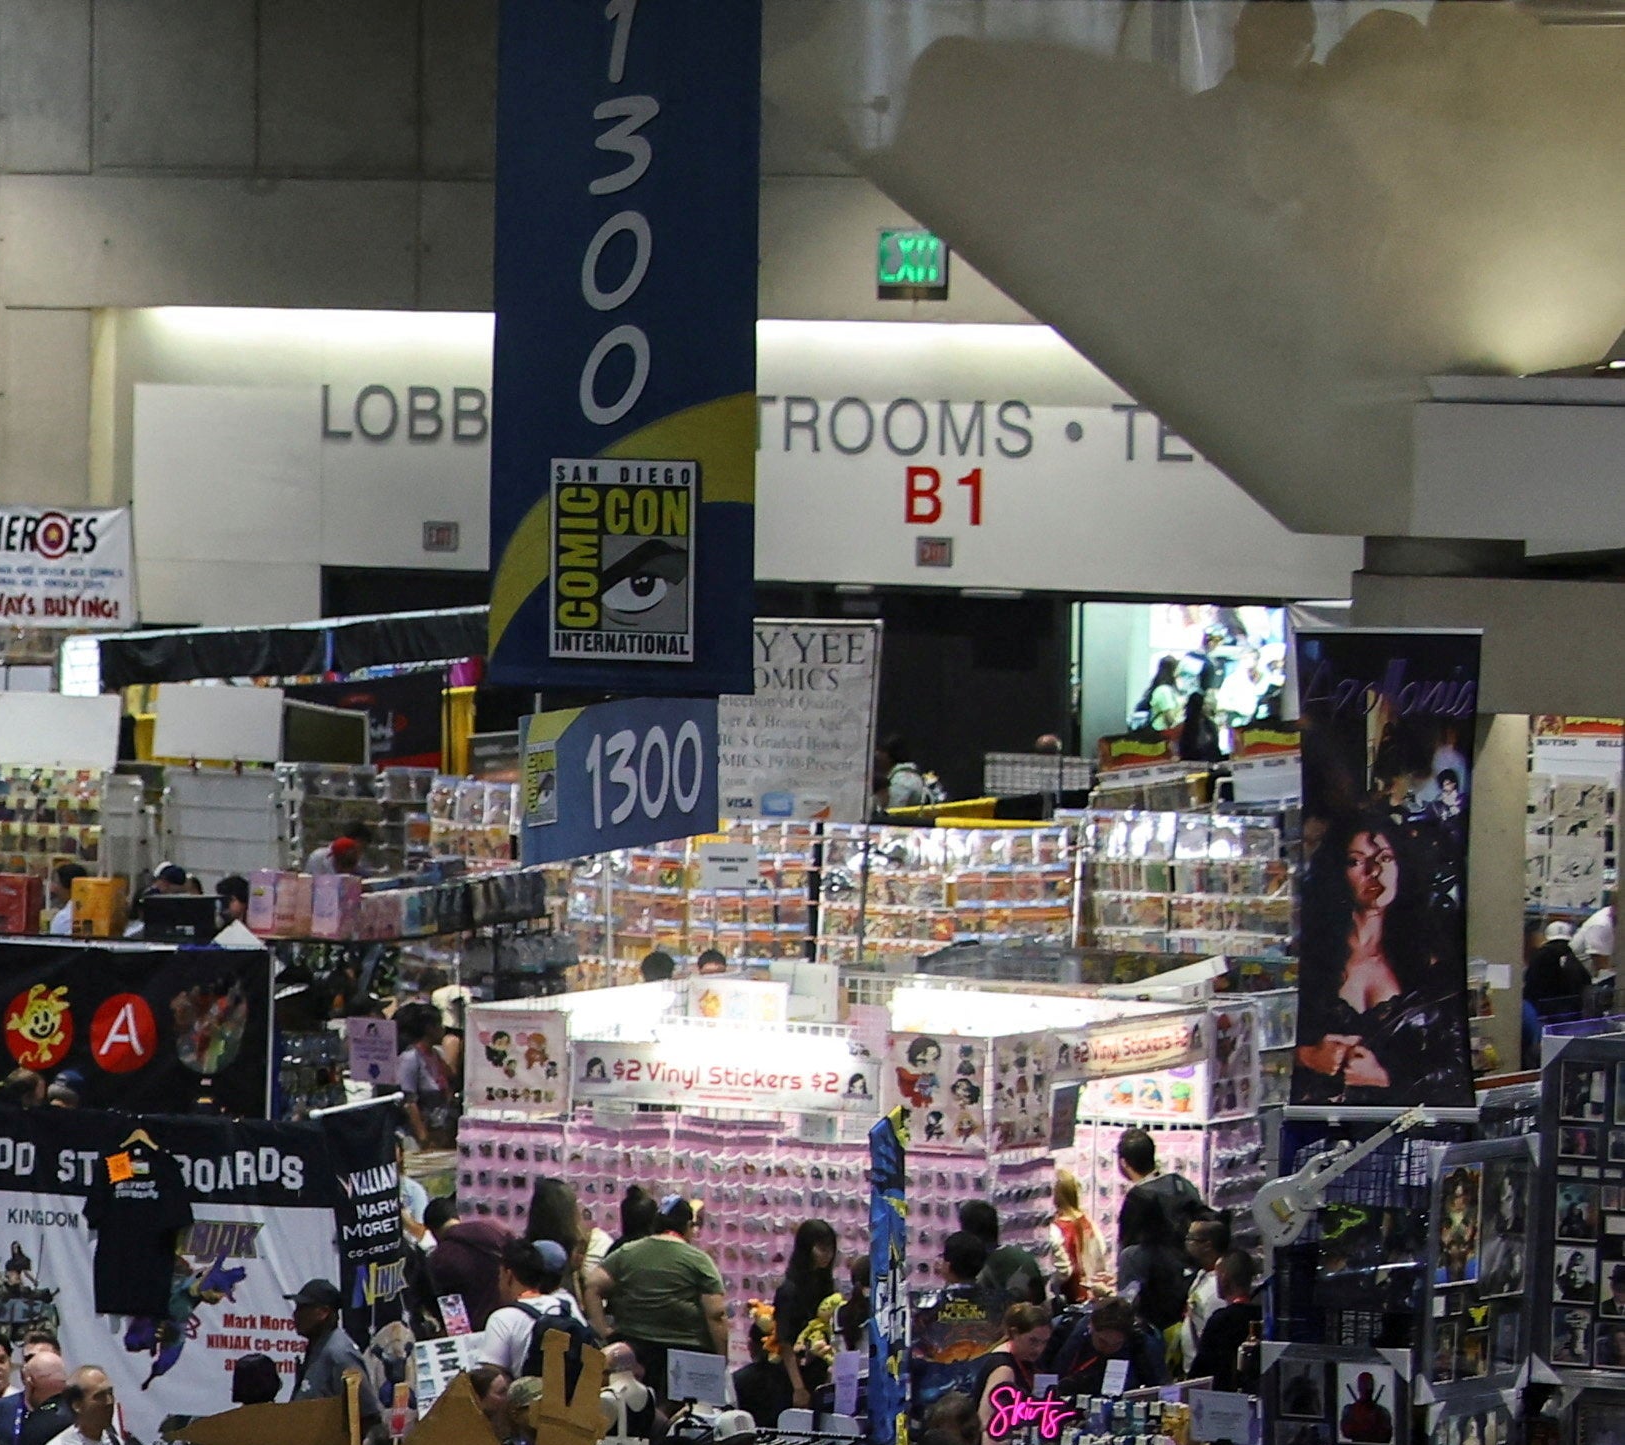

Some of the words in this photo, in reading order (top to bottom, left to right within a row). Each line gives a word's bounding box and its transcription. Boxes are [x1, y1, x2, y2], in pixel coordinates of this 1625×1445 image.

[555, 465, 596, 483] SAN
[619, 466, 692, 486] DIEGO
[604, 487, 689, 536] CON
[558, 486, 599, 628] COMIC
[44, 592, 121, 620] BUYING!
[554, 633, 691, 657] INTERNATIONAL
[586, 719, 704, 829] 1300
[612, 1063, 642, 1083] $2
[645, 1064, 704, 1090] Vinyl
[708, 1066, 803, 1091] Stickers
[811, 1073, 840, 1094] $2
[7, 1209, 80, 1230] KINGDOM
[355, 1197, 399, 1220] MARK
[222, 1313, 257, 1330] Mark
[206, 1333, 252, 1351] NINJAK
[989, 1385, 1077, 1438] Skirts
